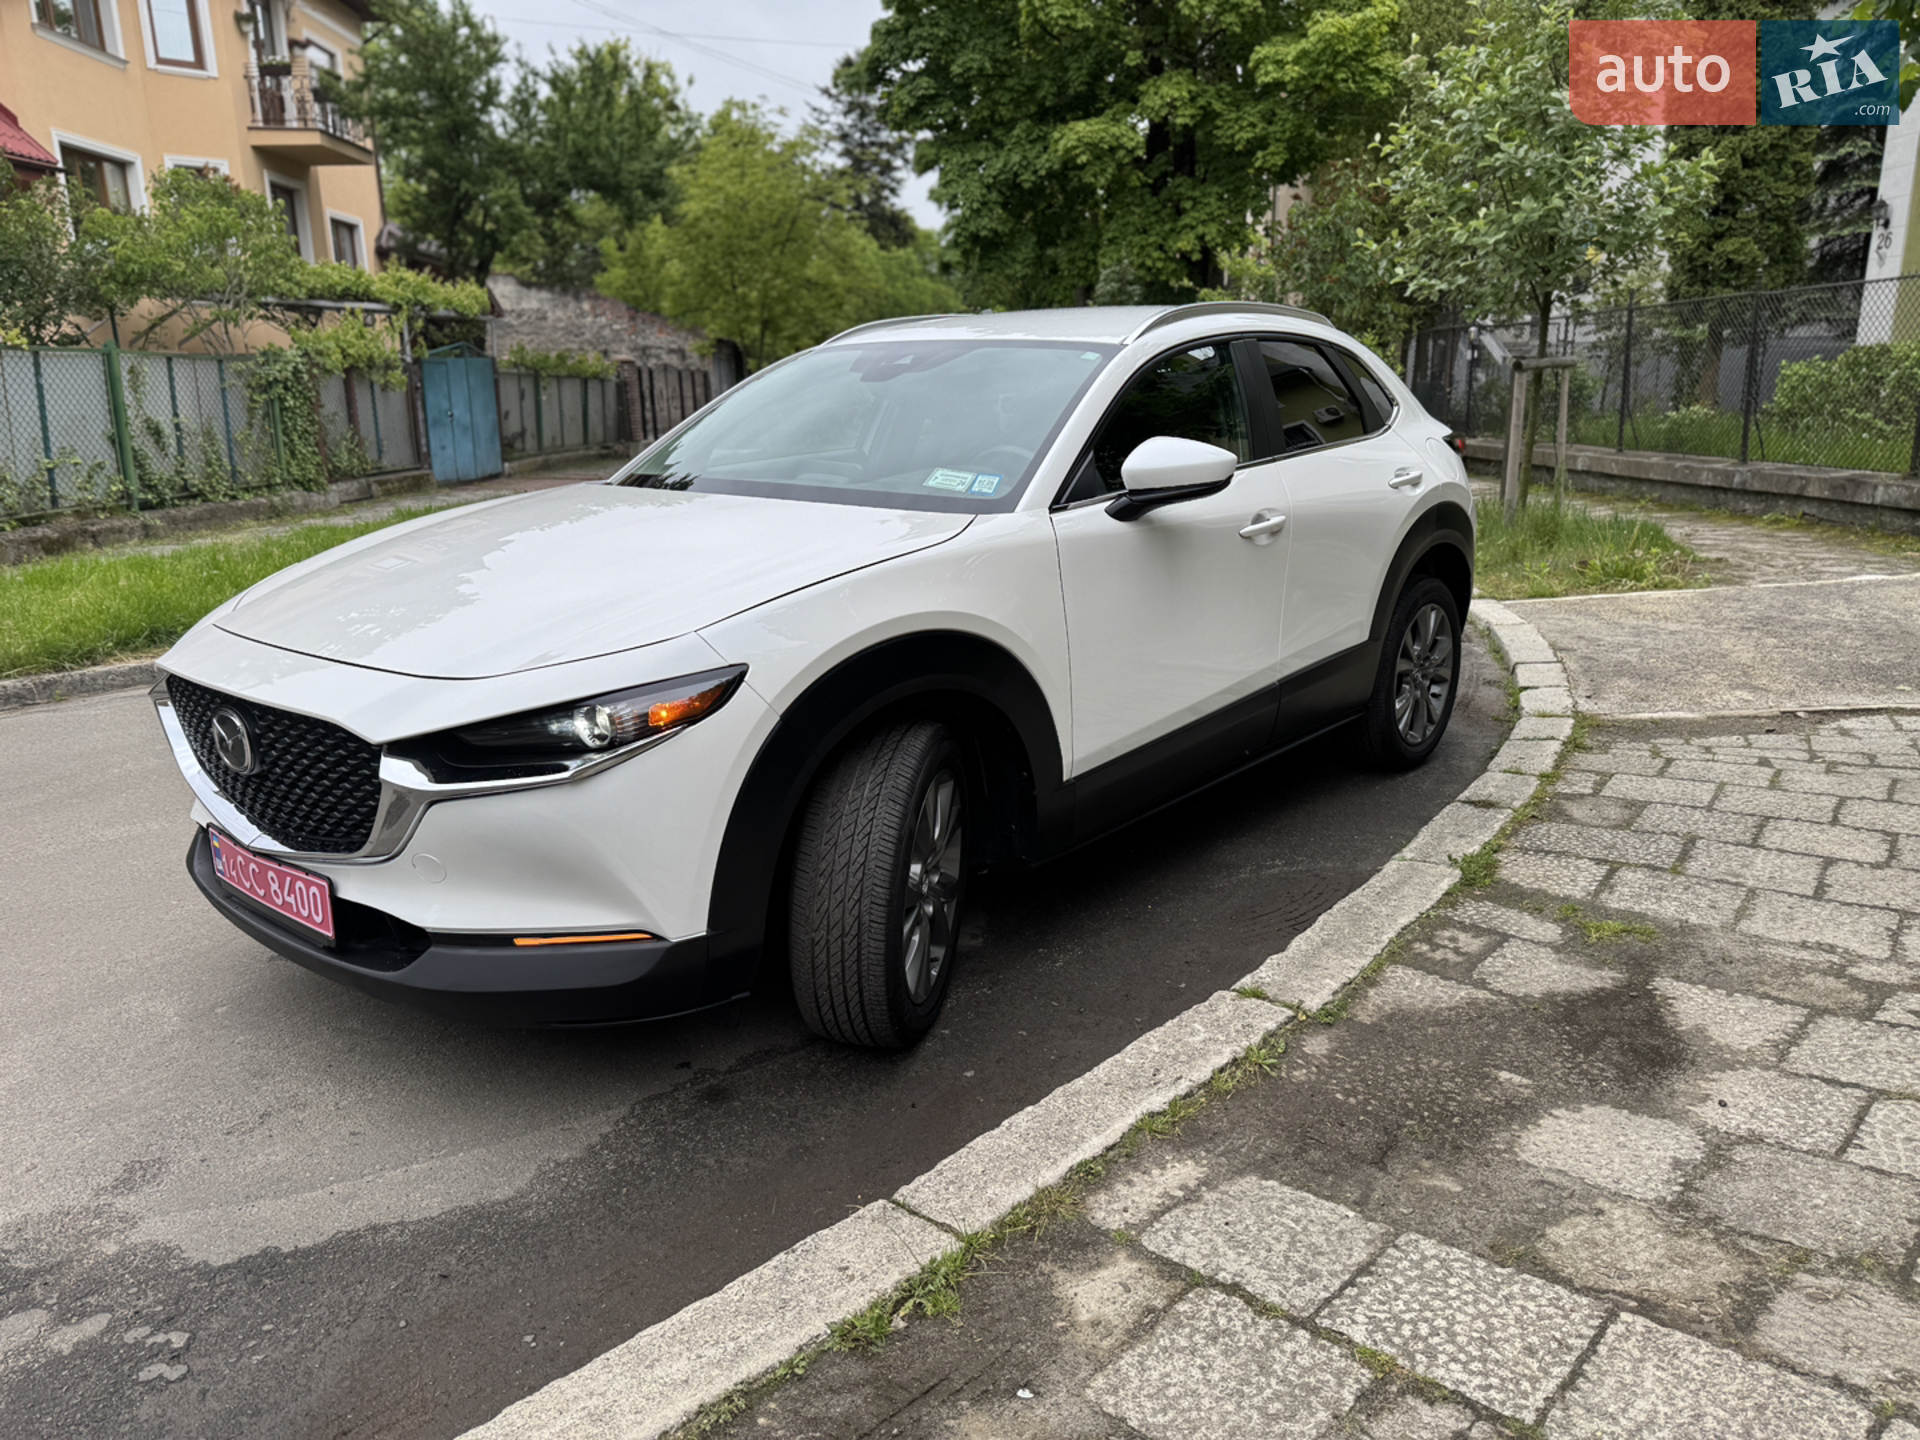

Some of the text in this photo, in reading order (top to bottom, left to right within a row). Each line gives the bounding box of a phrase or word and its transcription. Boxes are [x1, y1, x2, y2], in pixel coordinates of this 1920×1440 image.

[1877, 231, 1893, 250] 26
[222, 854, 323, 924] 14CC 8400
